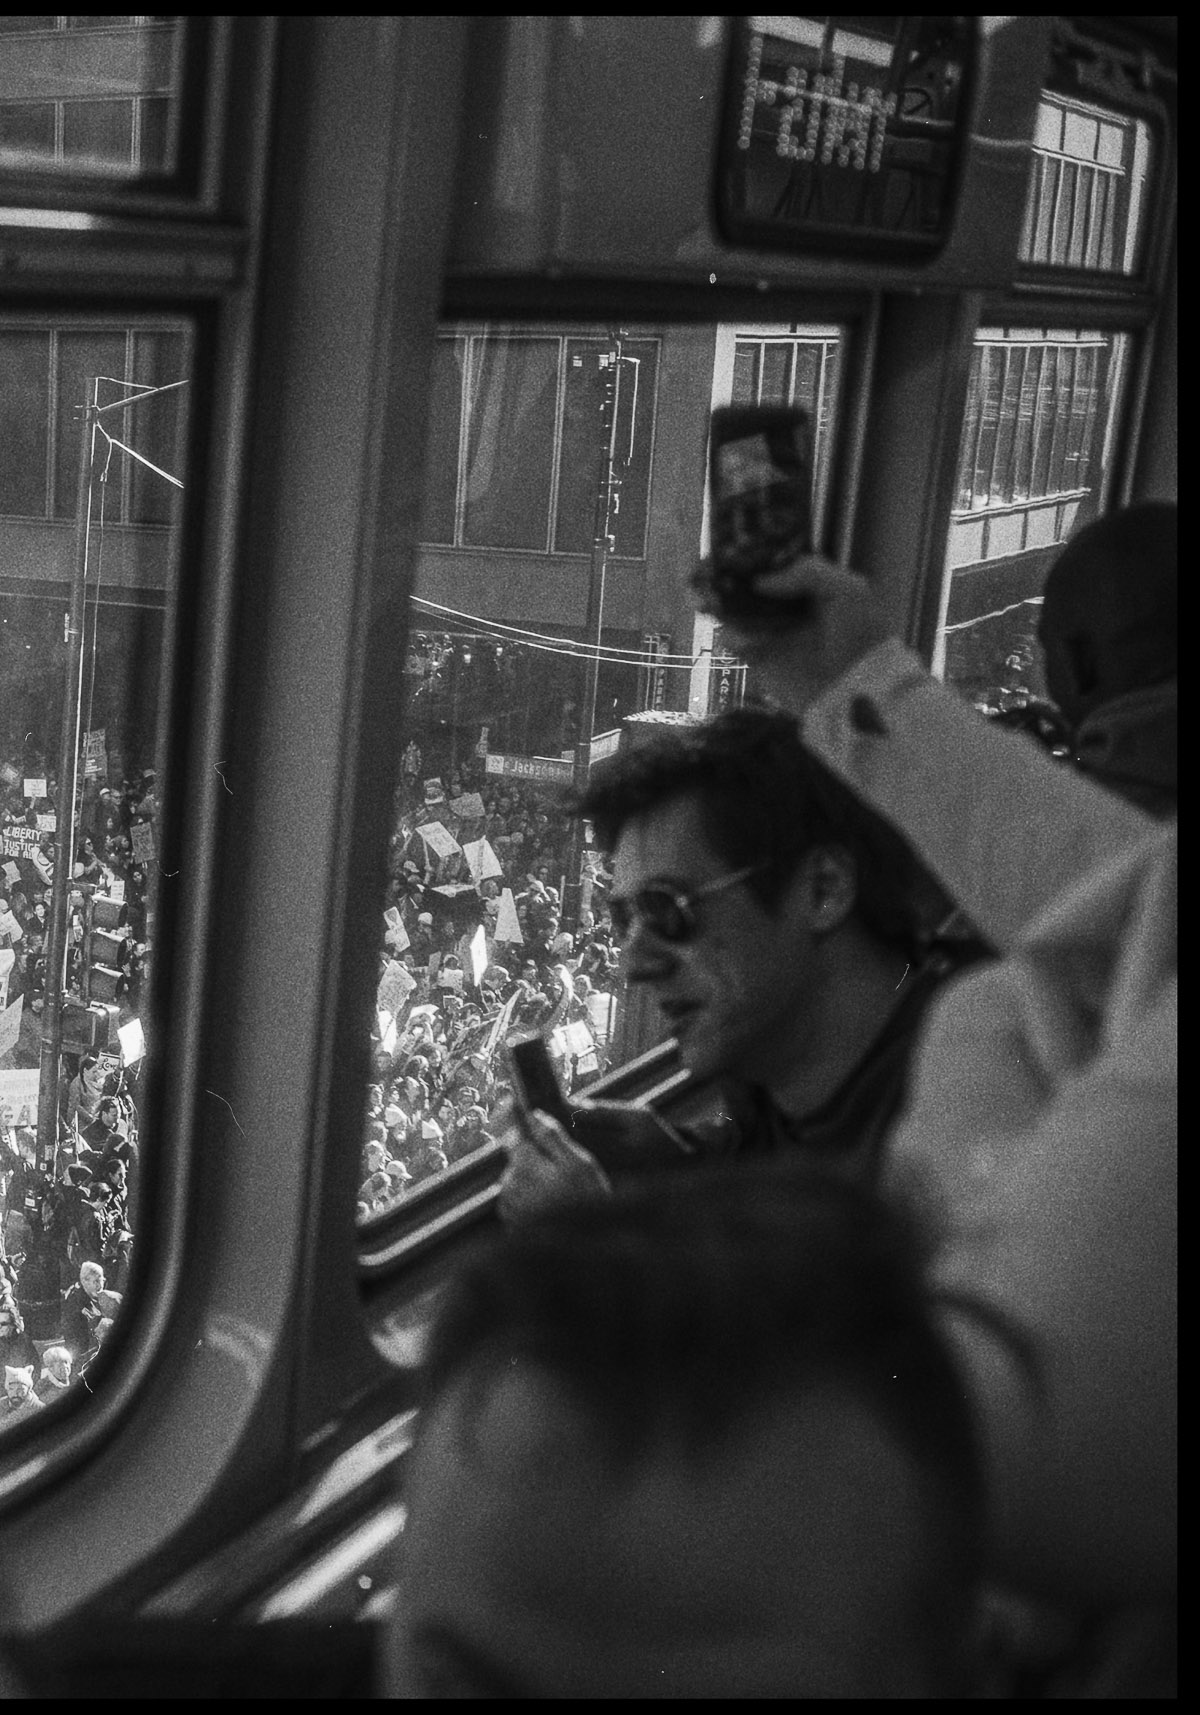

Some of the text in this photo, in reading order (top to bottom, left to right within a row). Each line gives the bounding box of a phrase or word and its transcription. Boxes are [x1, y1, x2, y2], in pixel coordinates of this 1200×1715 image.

[7, 827, 42, 841] LIBERTY
[4, 839, 40, 850] JUSTICE
[4, 848, 19, 857] FOR
